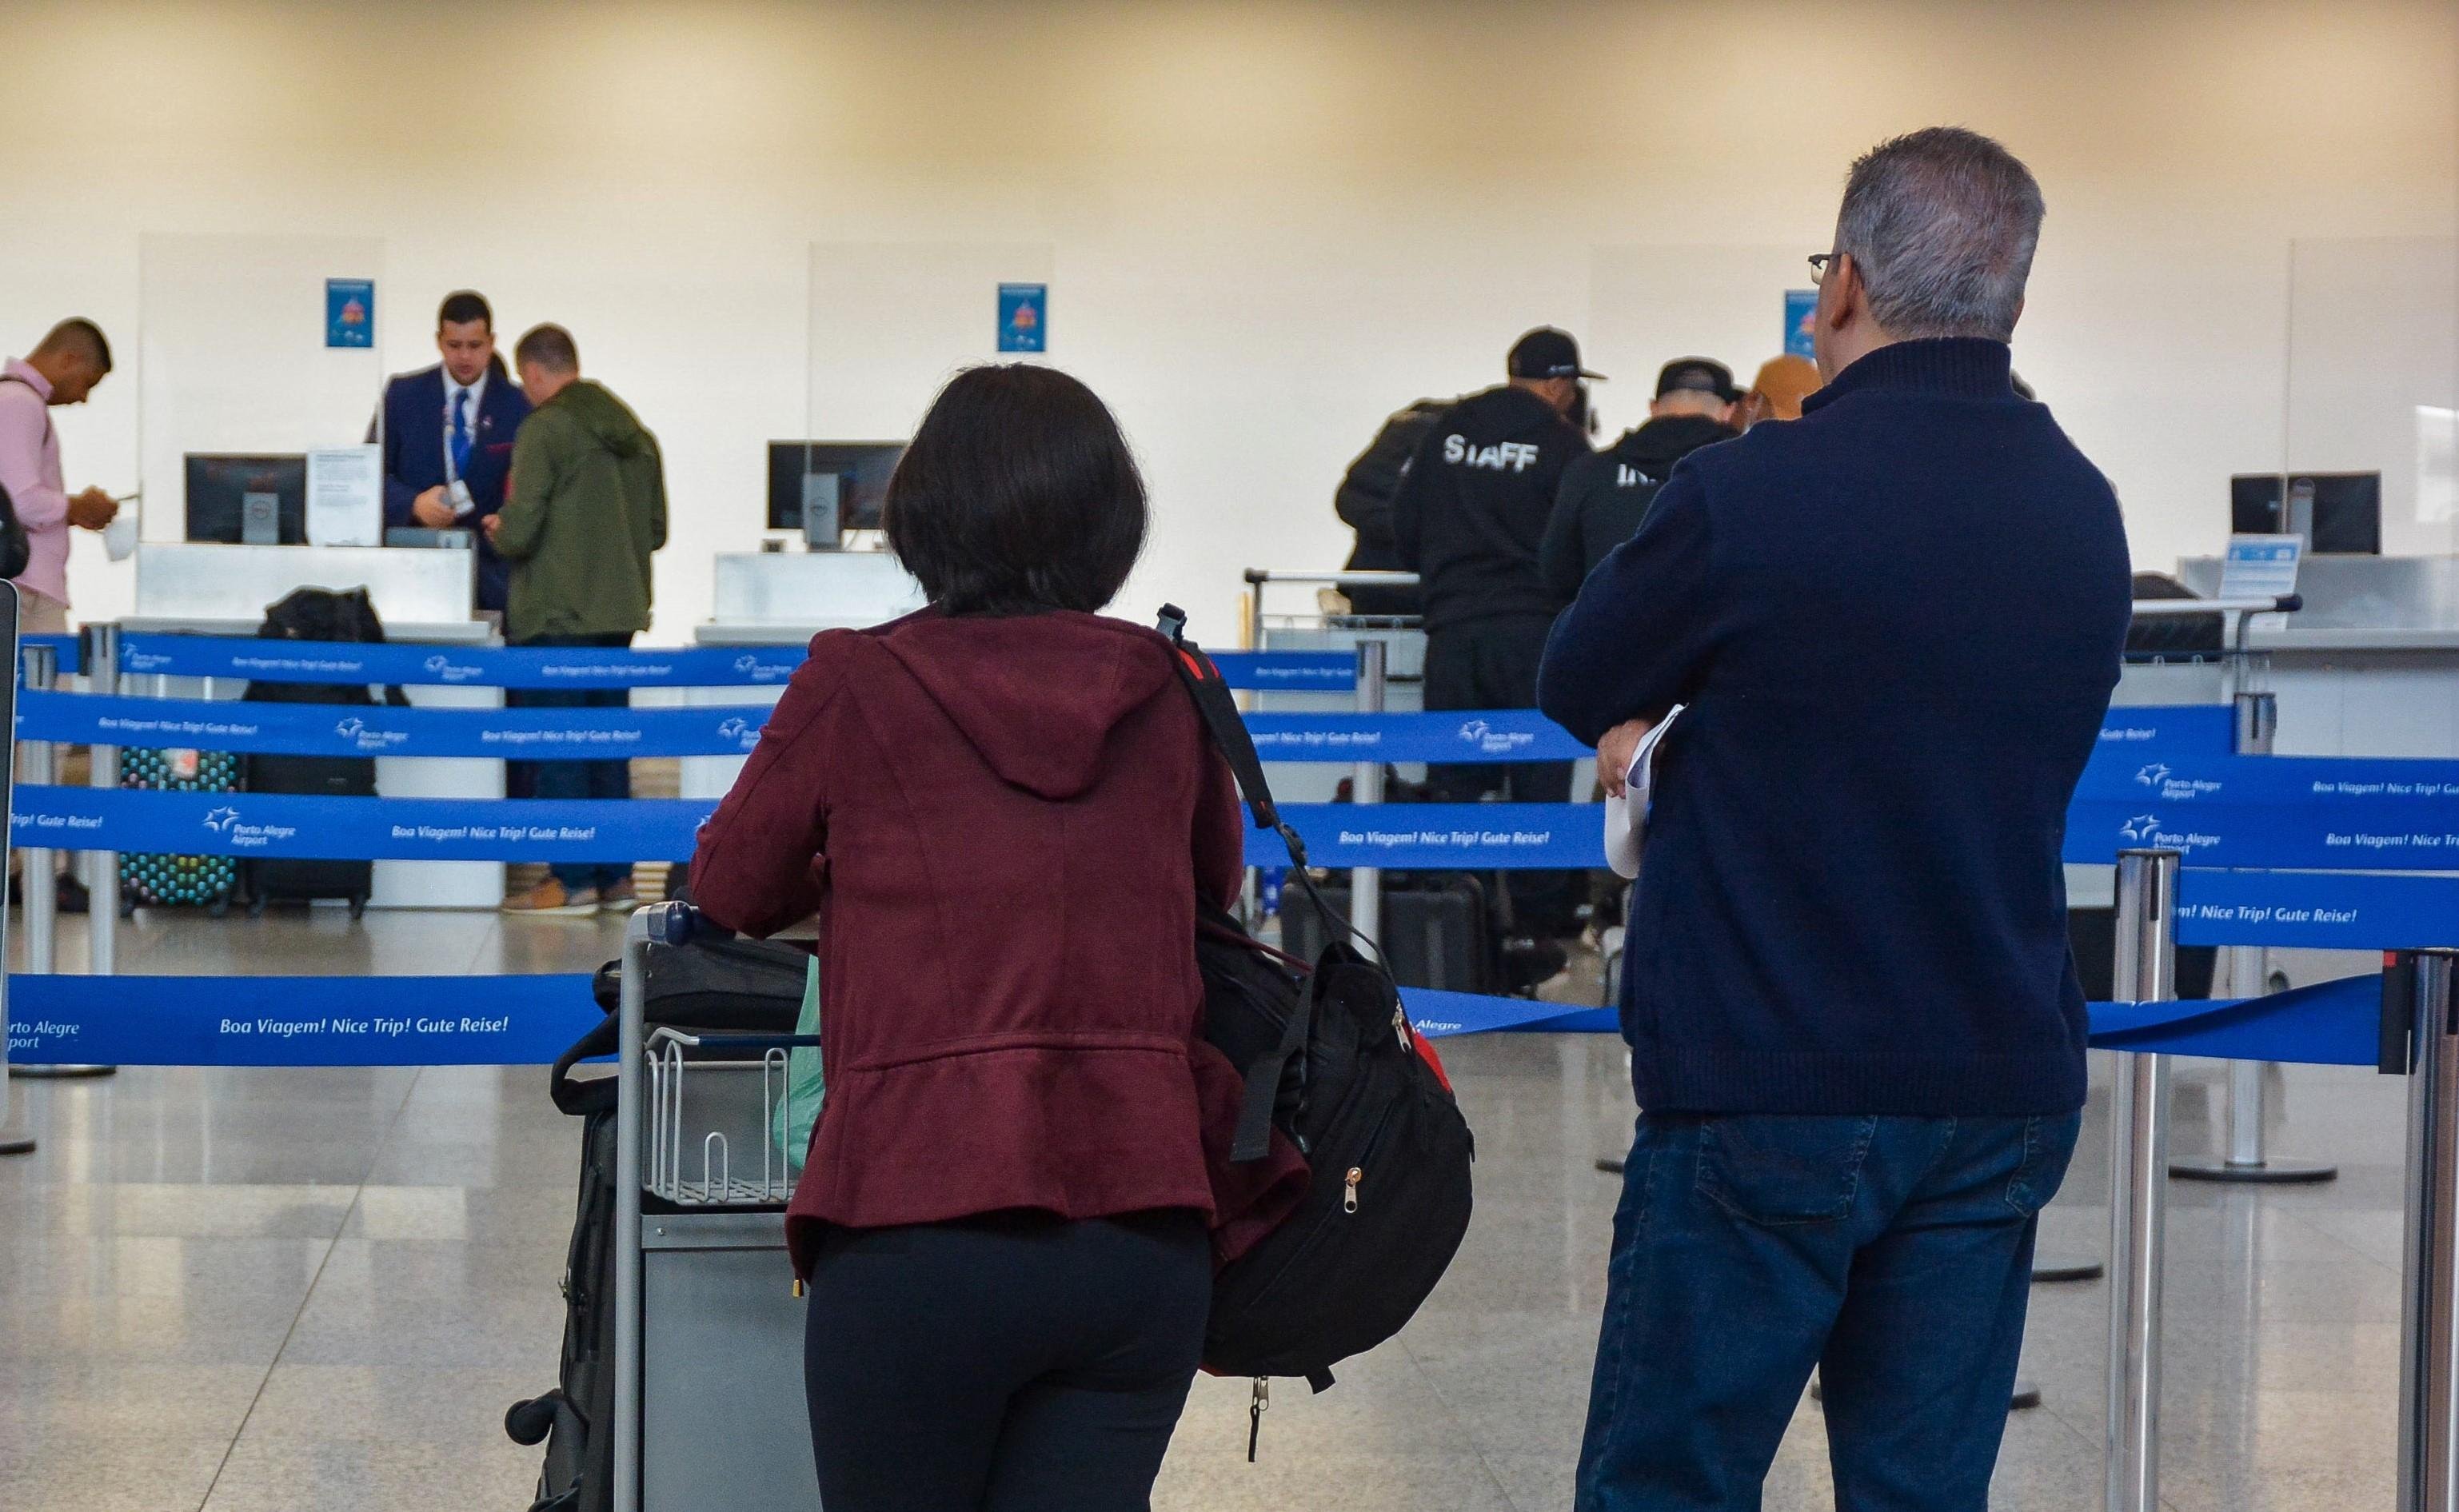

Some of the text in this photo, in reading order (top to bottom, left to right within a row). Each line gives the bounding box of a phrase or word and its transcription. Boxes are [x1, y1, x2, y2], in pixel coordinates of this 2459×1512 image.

[2313, 781, 2335, 792] Boa
[2338, 781, 2385, 796] Viagem!
[2387, 782, 2413, 793] Nice
[2415, 782, 2441, 796] Trip!
[37, 814, 66, 826] Gute
[67, 816, 102, 828] Reise!
[233, 824, 296, 839] Porto Alegre
[391, 825, 596, 842] Boa Viagem! Nice Trip! Gute Reise!
[231, 835, 268, 847] Airport
[1339, 832, 1550, 848] Boa Viagem! Nice Trip! Gute Reise!
[2154, 832, 2221, 847] Porto Alegre
[2325, 833, 2351, 846] Boa
[2355, 833, 2409, 848] Viagem!
[2412, 833, 2441, 846] Nice
[2201, 904, 2234, 919] Nice
[2238, 906, 2271, 924] Trip!
[2275, 908, 2309, 921] Gute
[2313, 908, 2357, 923] Reise!
[10, 1020, 80, 1038] rto Alegre
[220, 1016, 509, 1037] Boa Viagem! Nice Trip! Gute Reise!
[1415, 1019, 1462, 1031] Alegre
[8, 1036, 39, 1051] port
